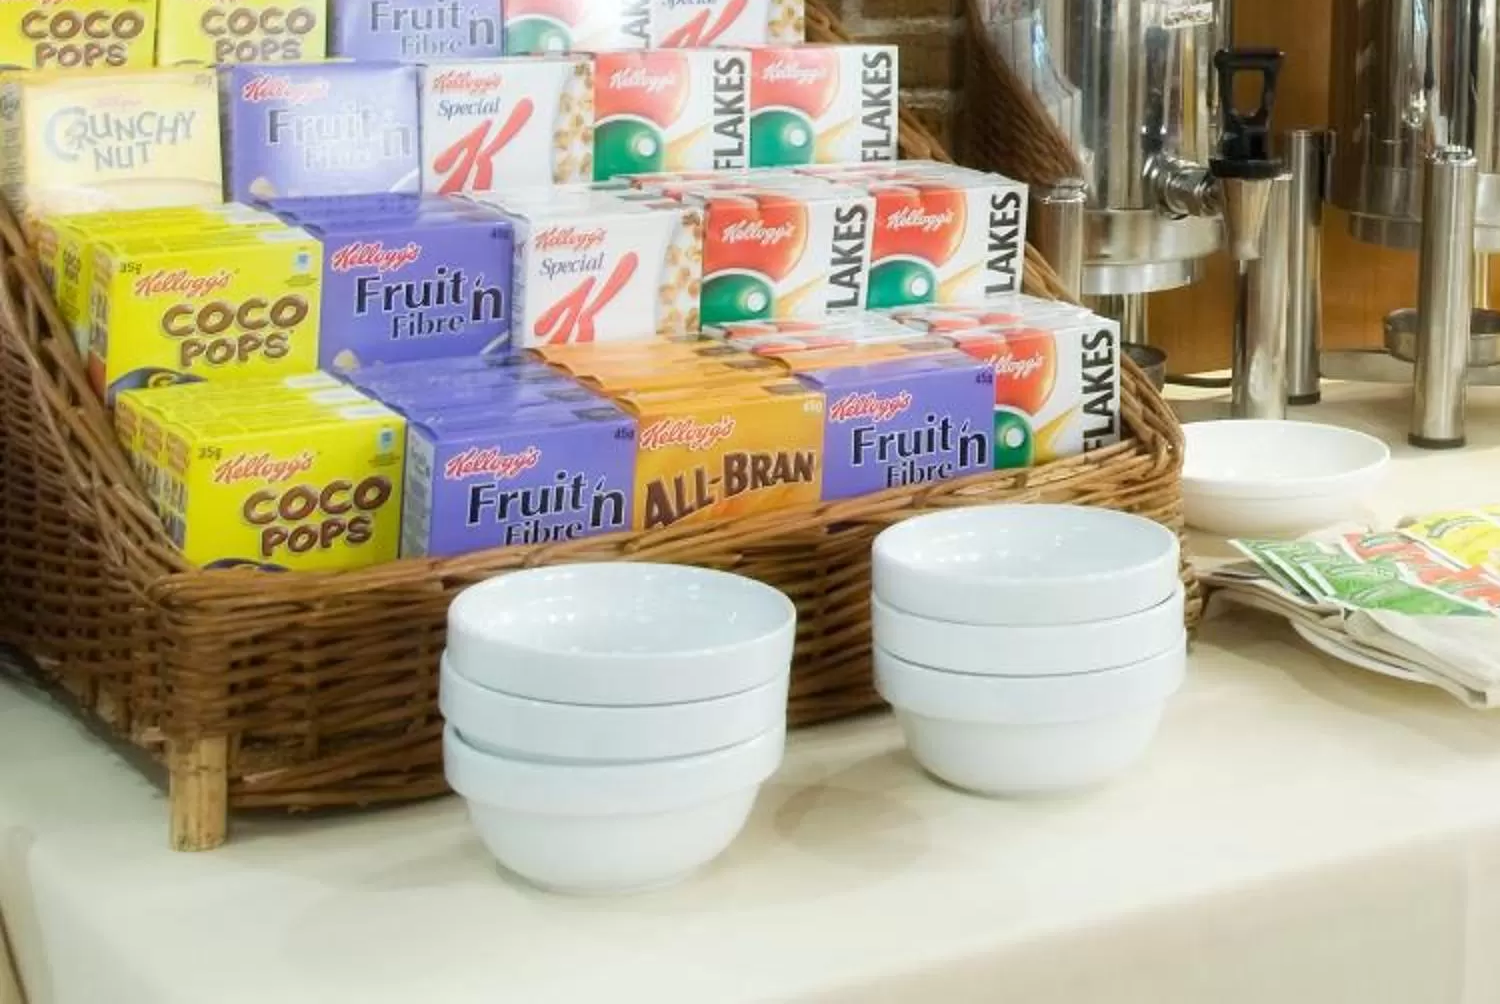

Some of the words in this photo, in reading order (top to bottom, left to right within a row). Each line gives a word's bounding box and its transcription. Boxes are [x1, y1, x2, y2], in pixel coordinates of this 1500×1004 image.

[21, 9, 144, 39] COCO
[201, 7, 316, 36] COCO
[35, 43, 128, 67] POPS
[215, 39, 302, 63] POPS
[401, 35, 463, 55] Fibre
[437, 97, 501, 119] Special
[45, 106, 197, 161] CRUNCHY
[433, 97, 534, 195] K
[93, 140, 154, 172] NUT
[721, 220, 796, 247] Kellogg's
[887, 205, 955, 232] Kellogg's
[332, 242, 421, 272] Kellogg's
[826, 204, 868, 309] LAKES
[985, 191, 1021, 294] LAKES
[540, 252, 605, 280] Special
[134, 268, 235, 297] Kellogg's
[355, 267, 468, 316] Fruit
[534, 252, 638, 345] K
[161, 294, 309, 337] COCO
[391, 312, 465, 339] Fibre
[180, 331, 290, 367] POPS
[829, 391, 914, 421] Kellogg's
[638, 415, 736, 450] Kellogg's
[852, 414, 954, 467] Fruit
[213, 452, 316, 484] Kellogg's
[444, 446, 542, 481] Kellogg's
[886, 459, 952, 489] Fibre
[242, 475, 392, 525] COCO
[467, 471, 588, 526] Fruit
[261, 515, 373, 557] POPS
[505, 520, 583, 546] Fibre
